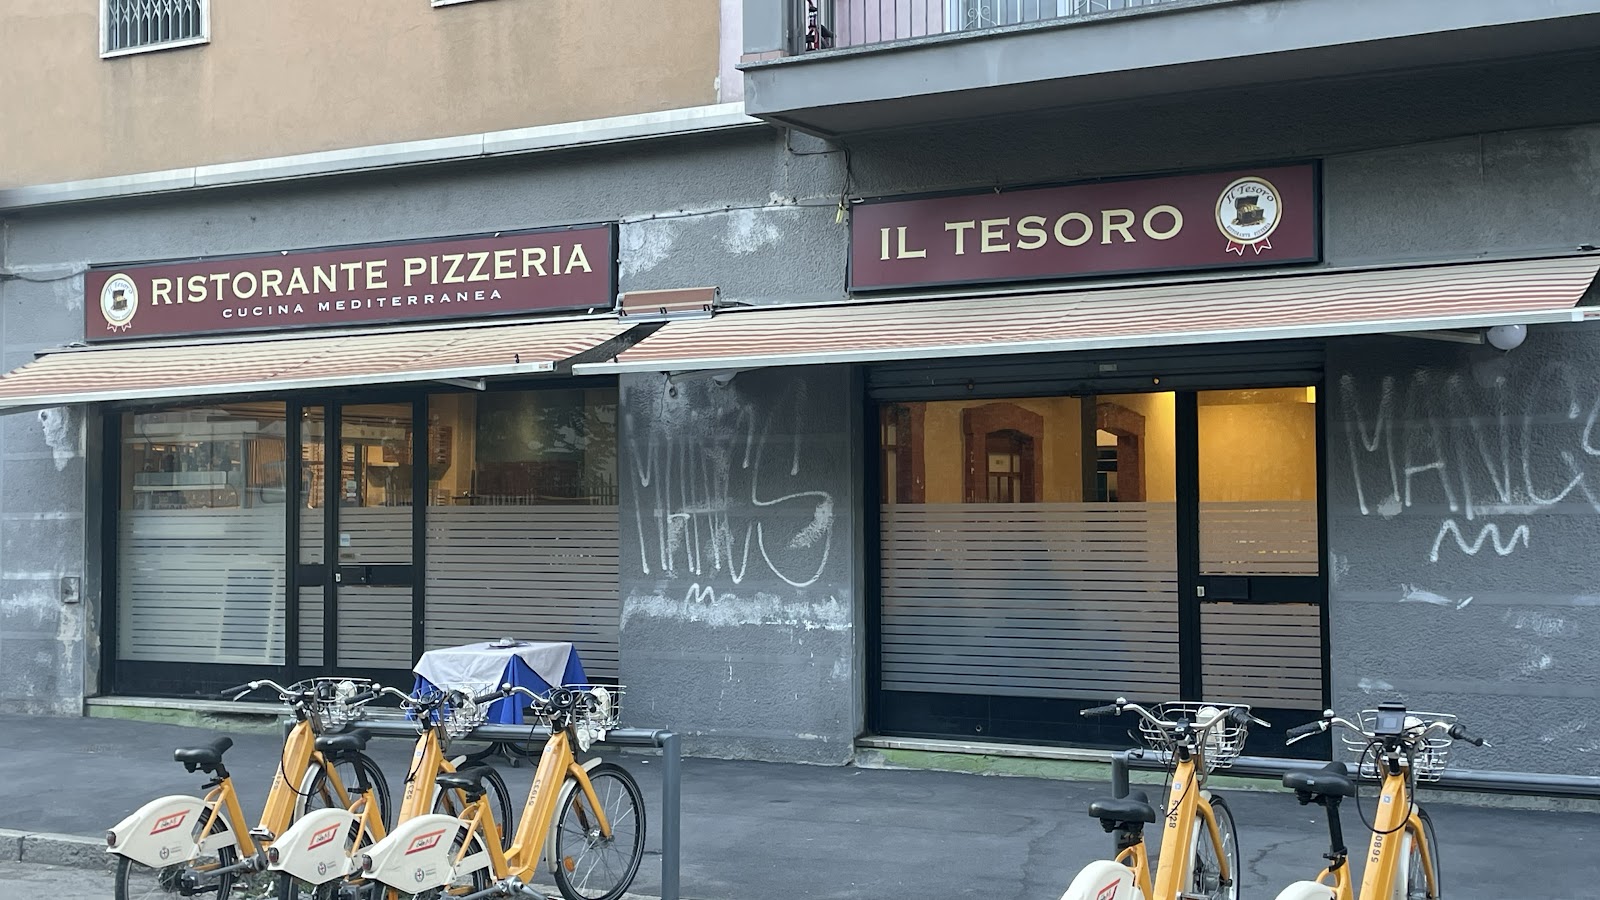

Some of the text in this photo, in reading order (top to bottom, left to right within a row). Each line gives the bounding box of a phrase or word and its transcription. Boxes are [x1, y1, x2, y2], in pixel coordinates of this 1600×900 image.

[1237, 184, 1274, 202] Tesoro
[880, 204, 1184, 261] IL TESORO
[151, 243, 593, 306] RISTORANTE PIZZERIA
[222, 289, 502, 318] CUCINA MEDITERRANEA
[528, 779, 542, 806] 51933
[1371, 835, 1383, 863] 5680
